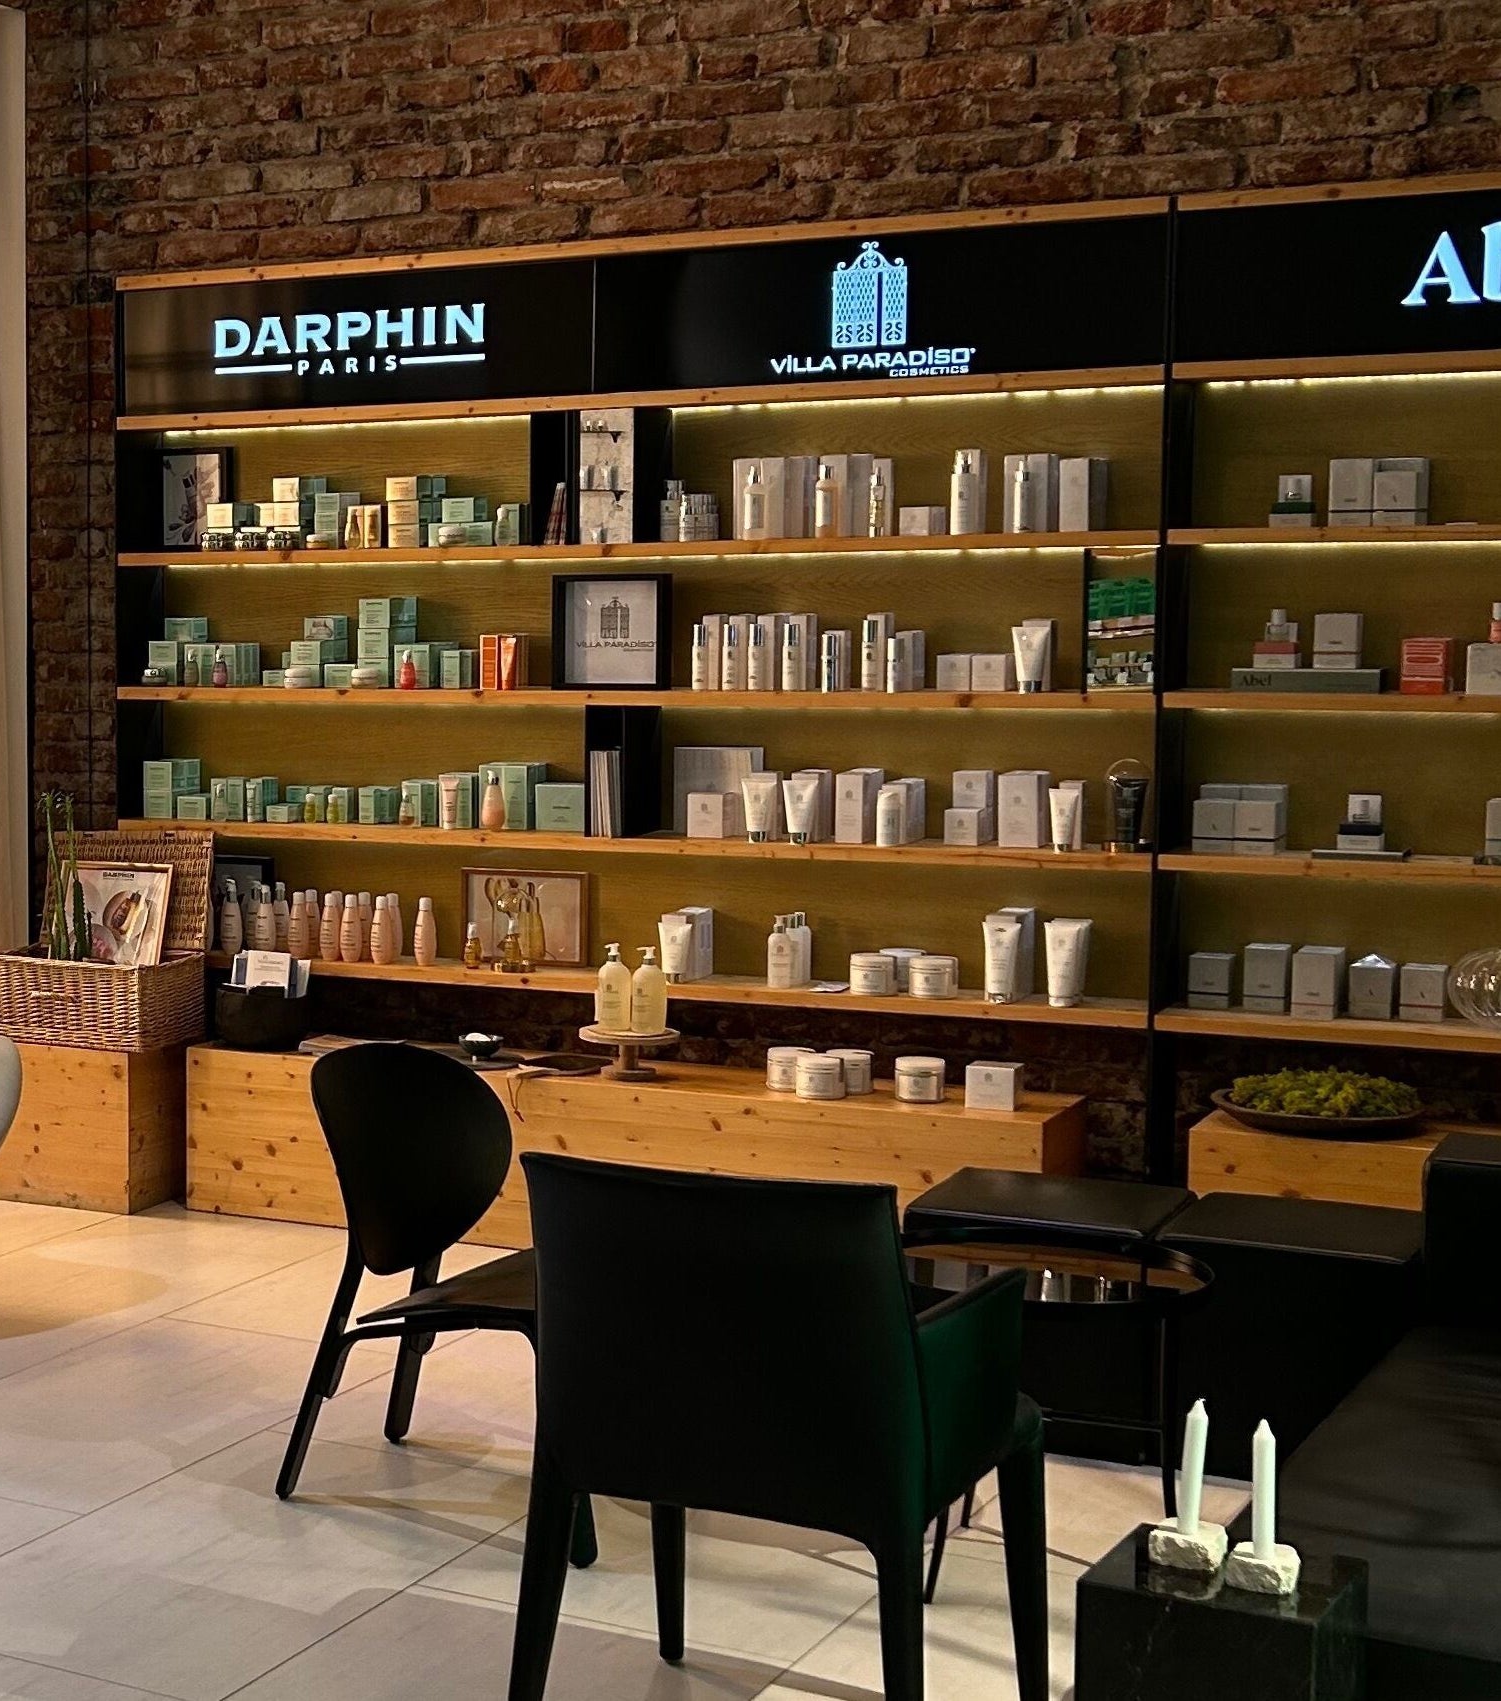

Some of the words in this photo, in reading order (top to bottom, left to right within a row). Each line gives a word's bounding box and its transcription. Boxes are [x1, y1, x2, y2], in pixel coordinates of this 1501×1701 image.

[214, 303, 485, 358] DARPHIN
[298, 355, 397, 375] PARIS
[889, 365, 970, 377] COSMETICS
